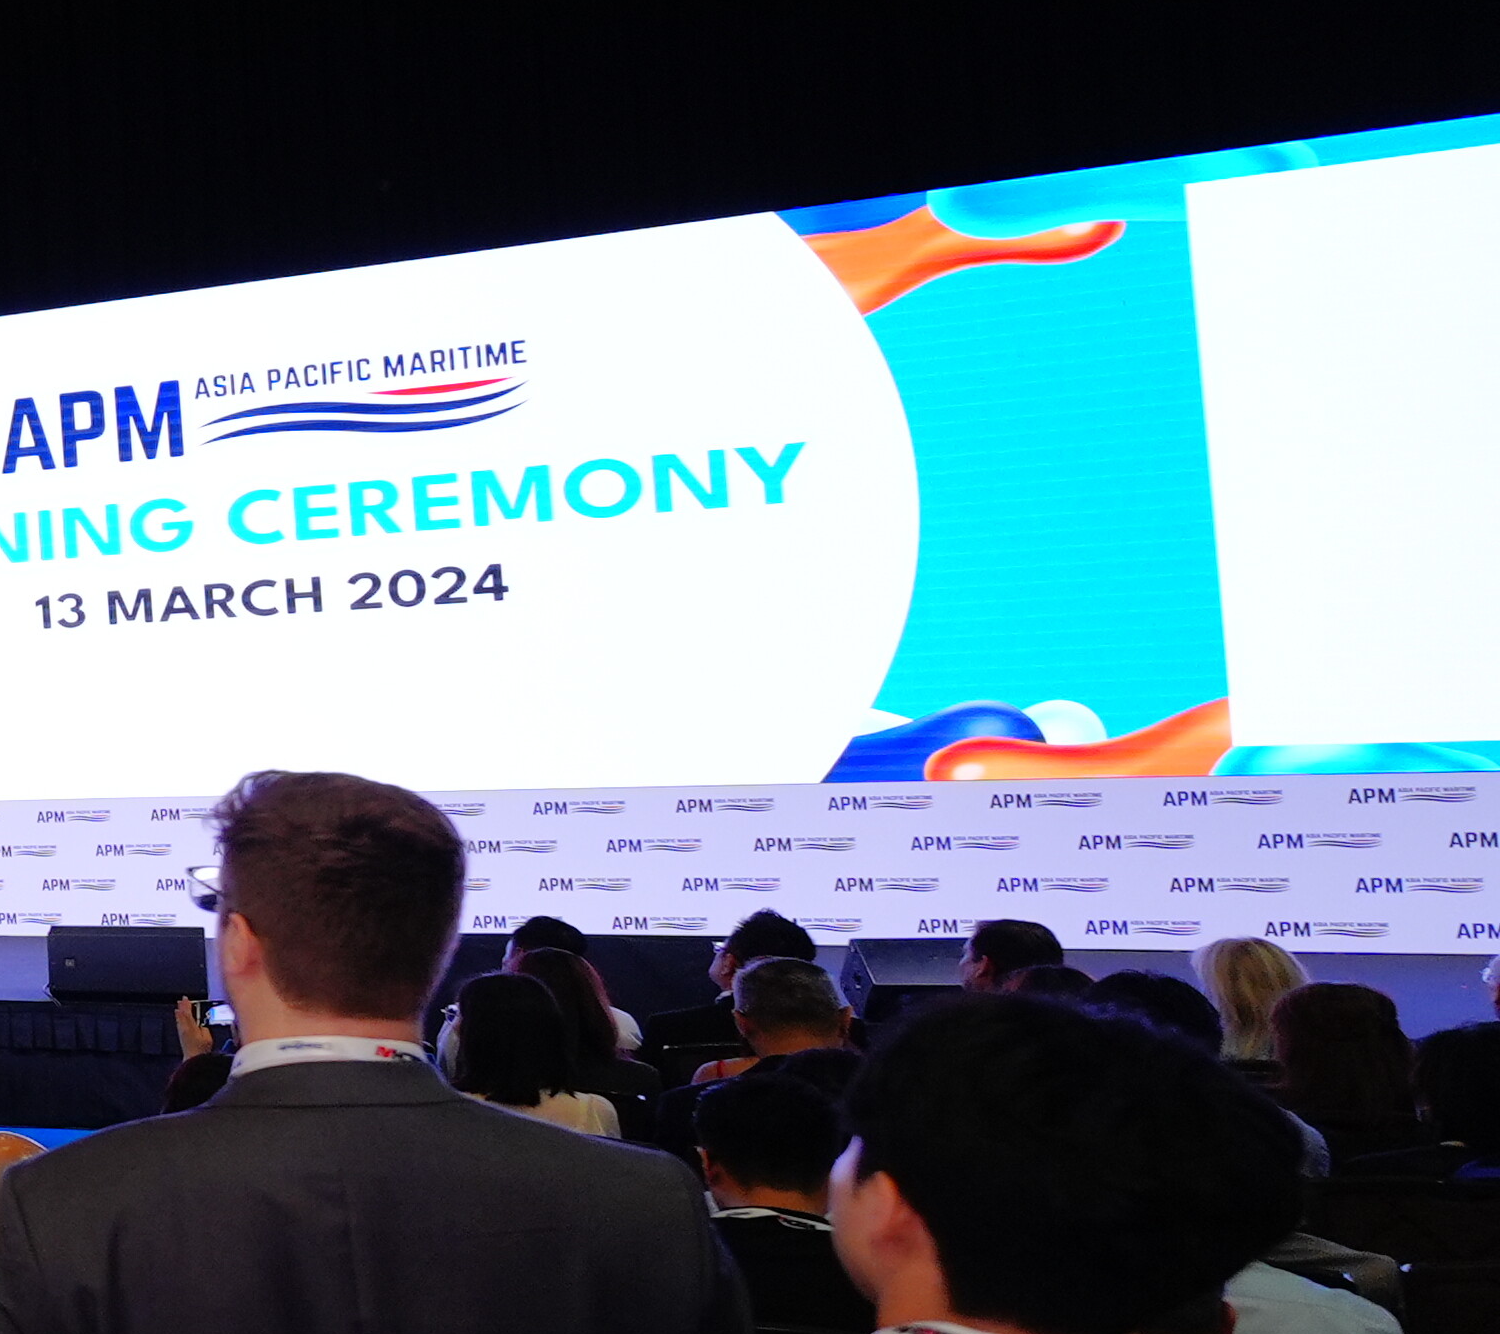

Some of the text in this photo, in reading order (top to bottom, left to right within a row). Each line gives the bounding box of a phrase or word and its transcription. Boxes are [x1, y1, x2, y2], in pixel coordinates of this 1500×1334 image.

[194, 338, 529, 402] ASIA PACIFIC MARITIME
[2, 380, 187, 476] APM
[228, 442, 807, 546] CEREMONY
[35, 564, 511, 630] 13 MARCH 2024
[991, 794, 1031, 808] APM
[1164, 791, 1207, 806] APM
[1349, 788, 1395, 803] APM
[533, 802, 567, 814] APM
[677, 799, 712, 812] APM
[829, 797, 866, 810] APM
[38, 811, 64, 822] APM
[151, 809, 180, 820] APM
[607, 839, 641, 852] APM
[755, 838, 791, 851] APM
[912, 837, 951, 850] APM
[1079, 835, 1121, 849] APM
[1258, 834, 1303, 848] APM
[1450, 832, 1498, 847] APM
[96, 845, 123, 855] APM
[467, 841, 500, 853] APM
[43, 879, 69, 890] APM
[157, 879, 185, 890] APM
[539, 878, 573, 891] APM
[683, 878, 718, 891] APM
[835, 878, 873, 891] APM
[997, 878, 1038, 892] APM
[1171, 878, 1214, 892] APM
[1356, 878, 1402, 892] APM
[101, 914, 129, 925] APM
[473, 916, 506, 928] APM
[613, 917, 647, 929] APM
[918, 919, 958, 933] APM
[1086, 920, 1128, 935] APM
[1265, 922, 1310, 937] APM
